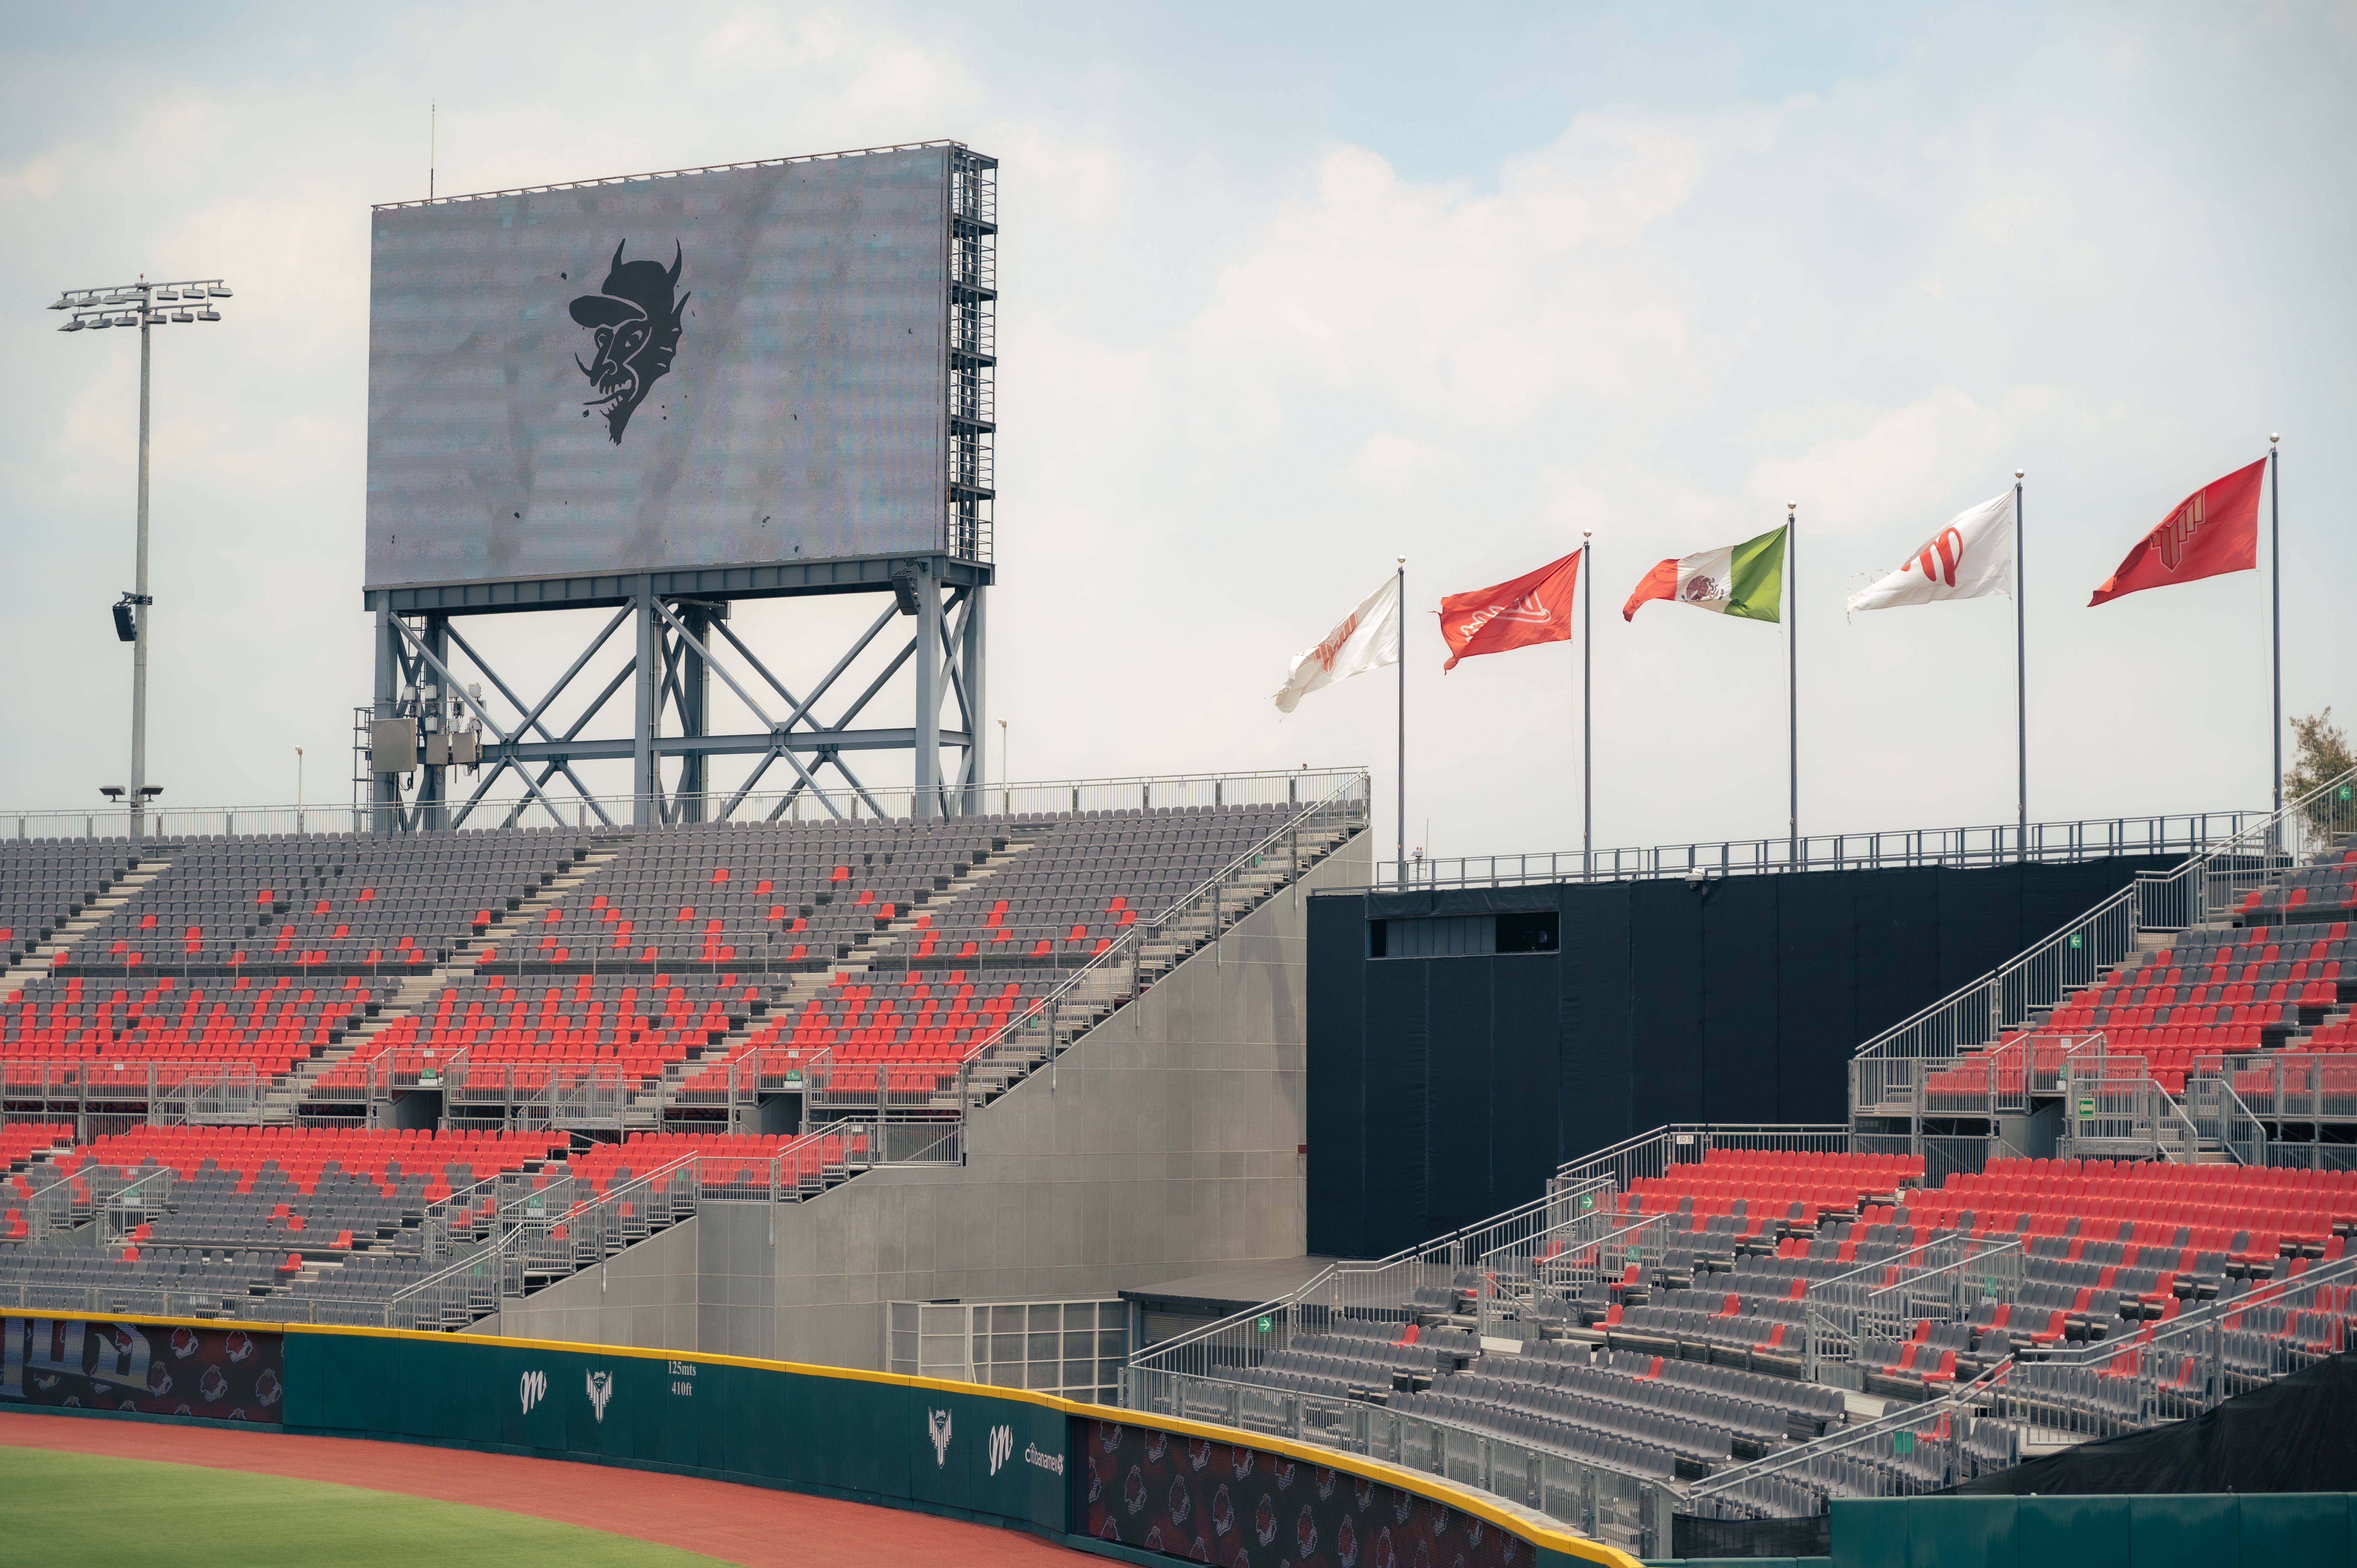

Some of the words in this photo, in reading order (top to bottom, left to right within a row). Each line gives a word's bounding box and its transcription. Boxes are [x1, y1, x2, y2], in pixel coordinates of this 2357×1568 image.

[668, 1360, 697, 1376] 125mts
[671, 1381, 693, 1396] 410ft
[1025, 1442, 1058, 1472] citibanamex
